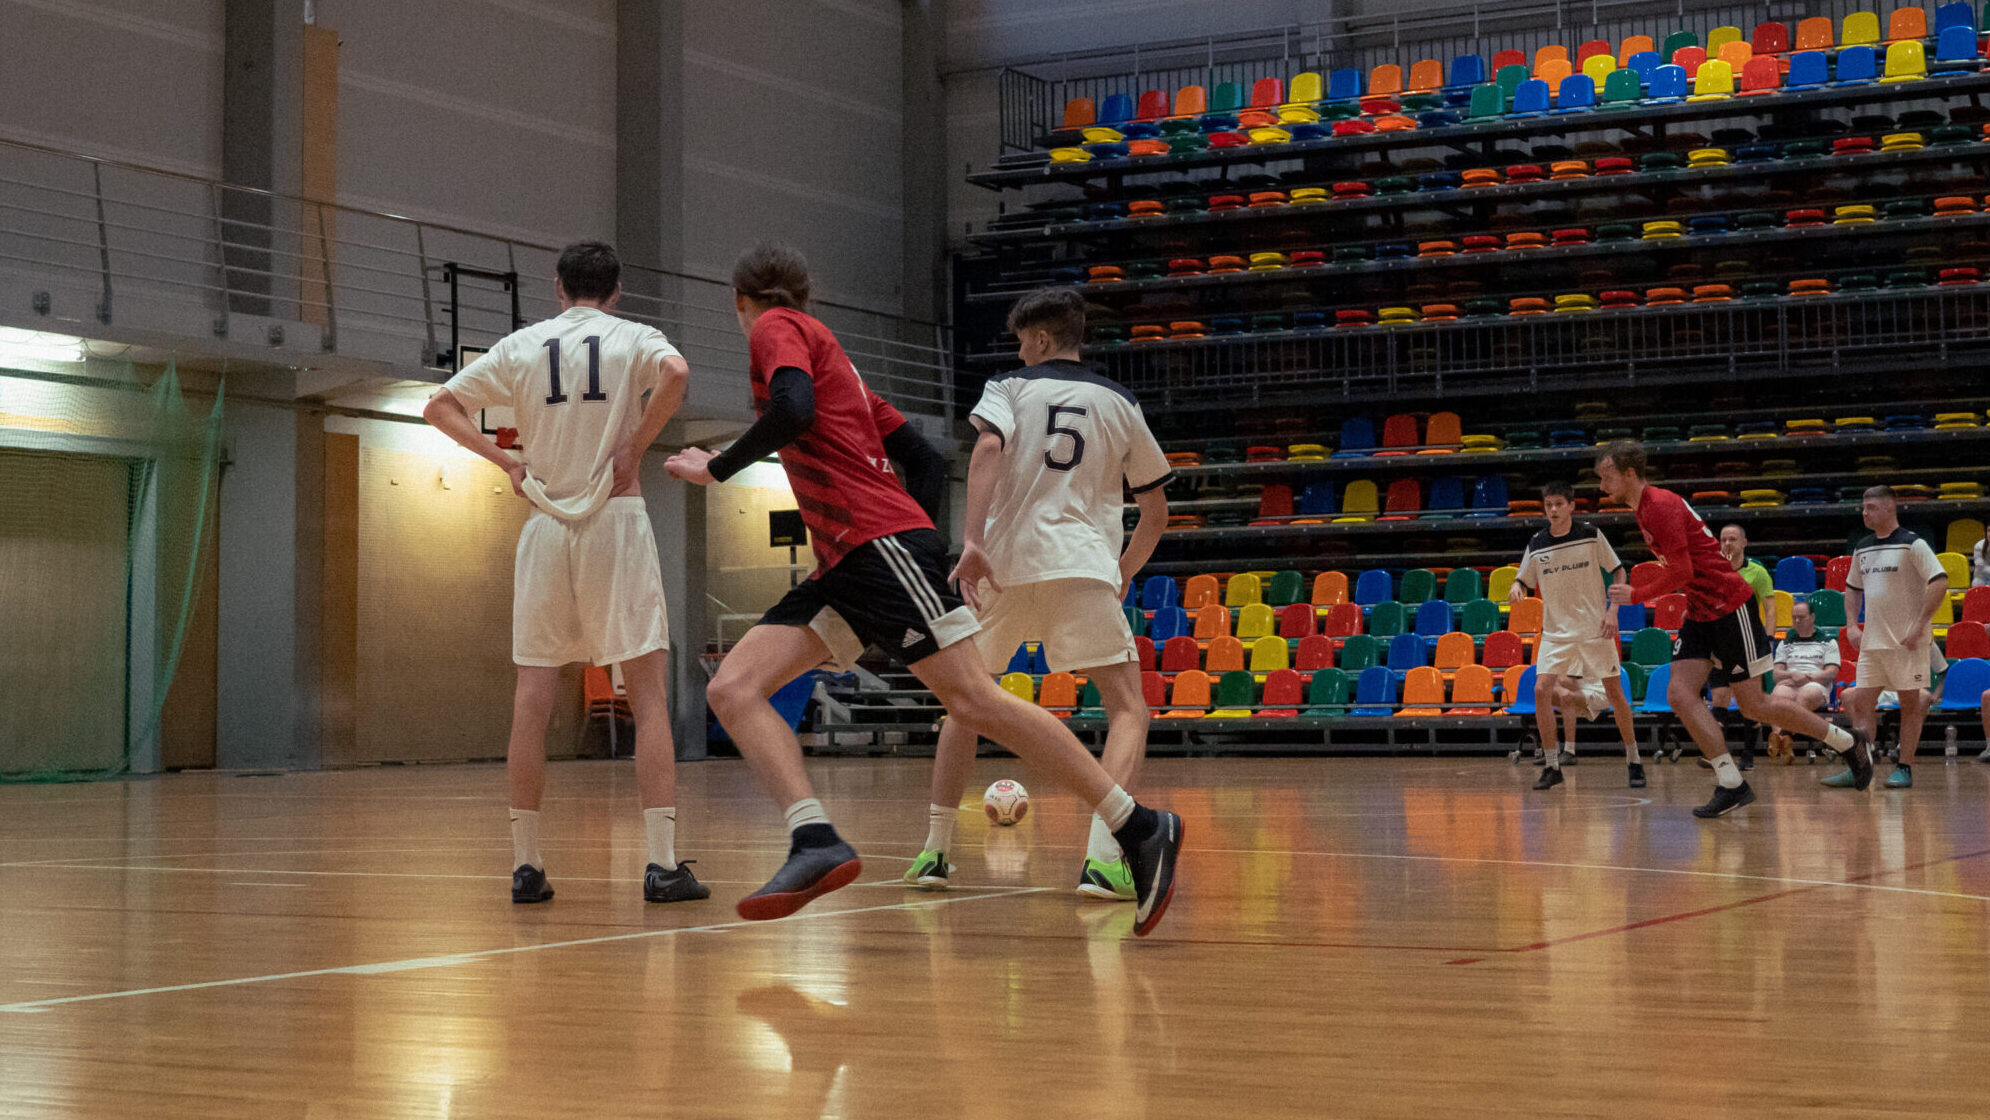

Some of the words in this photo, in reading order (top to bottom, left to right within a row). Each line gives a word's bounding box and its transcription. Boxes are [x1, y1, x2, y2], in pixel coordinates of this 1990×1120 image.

[543, 335, 607, 406] 11
[1045, 403, 1087, 472] 5
[1672, 638, 1682, 656] 9
